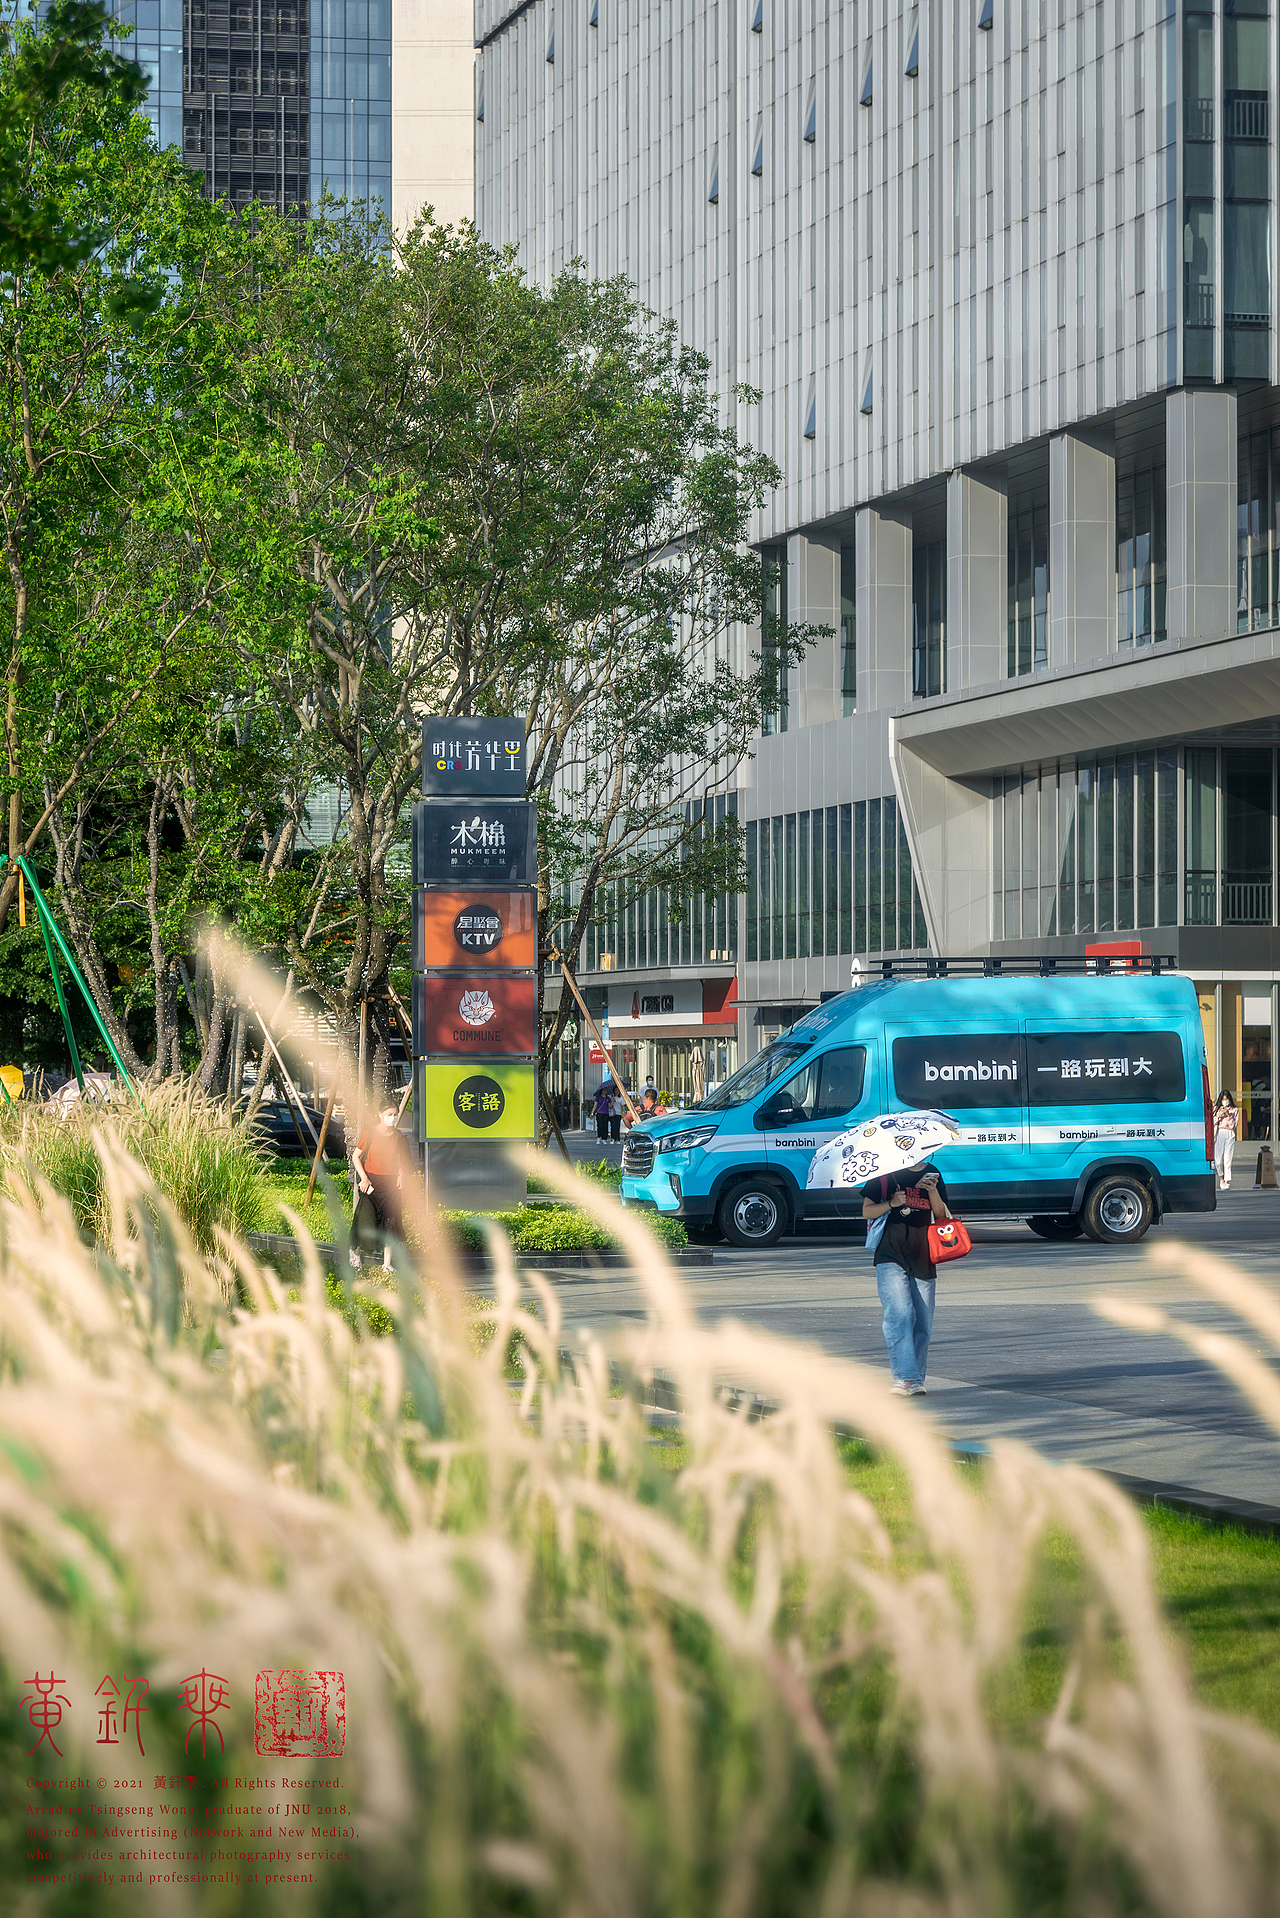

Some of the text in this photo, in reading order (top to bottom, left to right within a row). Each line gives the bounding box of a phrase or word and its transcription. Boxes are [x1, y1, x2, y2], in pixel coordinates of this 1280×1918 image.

[436, 759, 462, 771] CR8
[450, 820, 506, 847] 木棉
[462, 933, 495, 945] KTV
[453, 1030, 501, 1042] COMMUNE
[924, 1056, 1153, 1081] bambini 一路玩到大
[458, 1091, 500, 1112] 客語
[967, 1132, 1017, 1142] 一路玩到大
[1059, 1128, 1166, 1140] bambini 一路玩到大
[775, 1137, 816, 1148] bambini
[905, 1186, 921, 1198] THE
